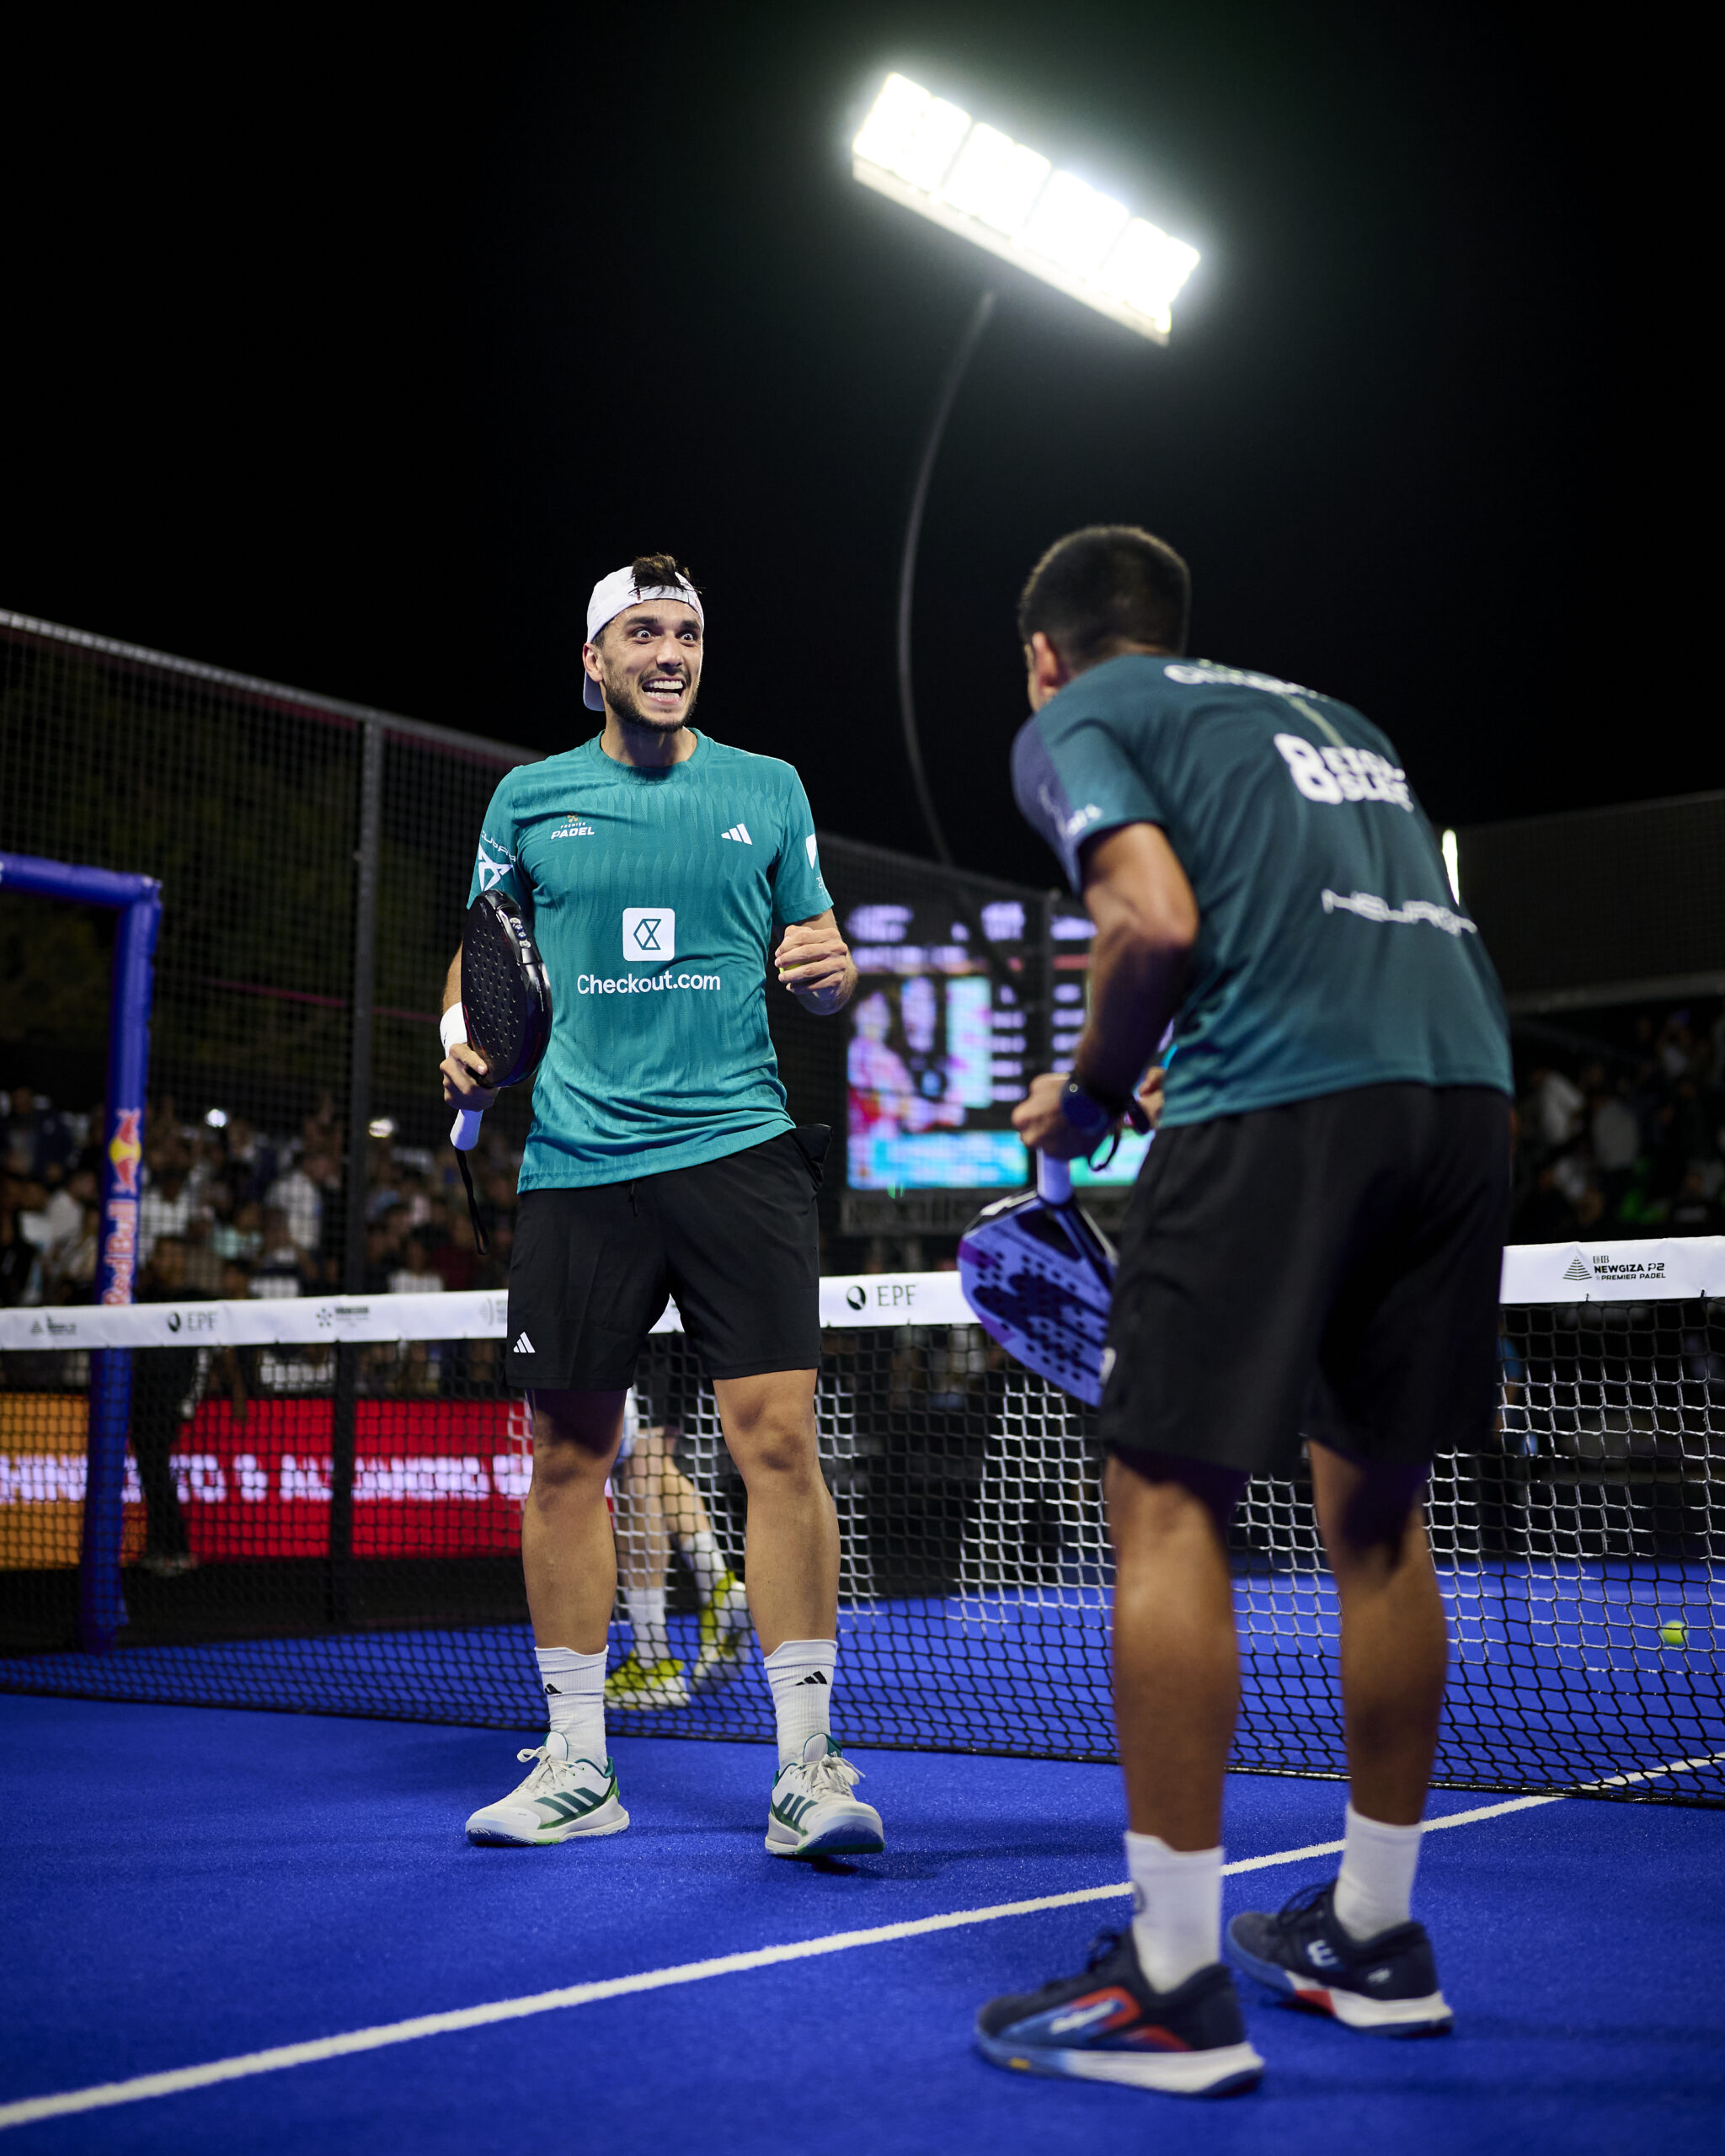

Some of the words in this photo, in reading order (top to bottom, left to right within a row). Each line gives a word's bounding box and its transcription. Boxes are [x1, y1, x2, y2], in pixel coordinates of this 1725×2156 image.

[550, 827, 595, 840] PADEL
[577, 970, 721, 995] Checkout.com
[107, 1199, 136, 1255] Bull
[1594, 1263, 1644, 1273] NEWGIZA
[1648, 1262, 1665, 1272] P2
[877, 1285, 916, 1306] EPF
